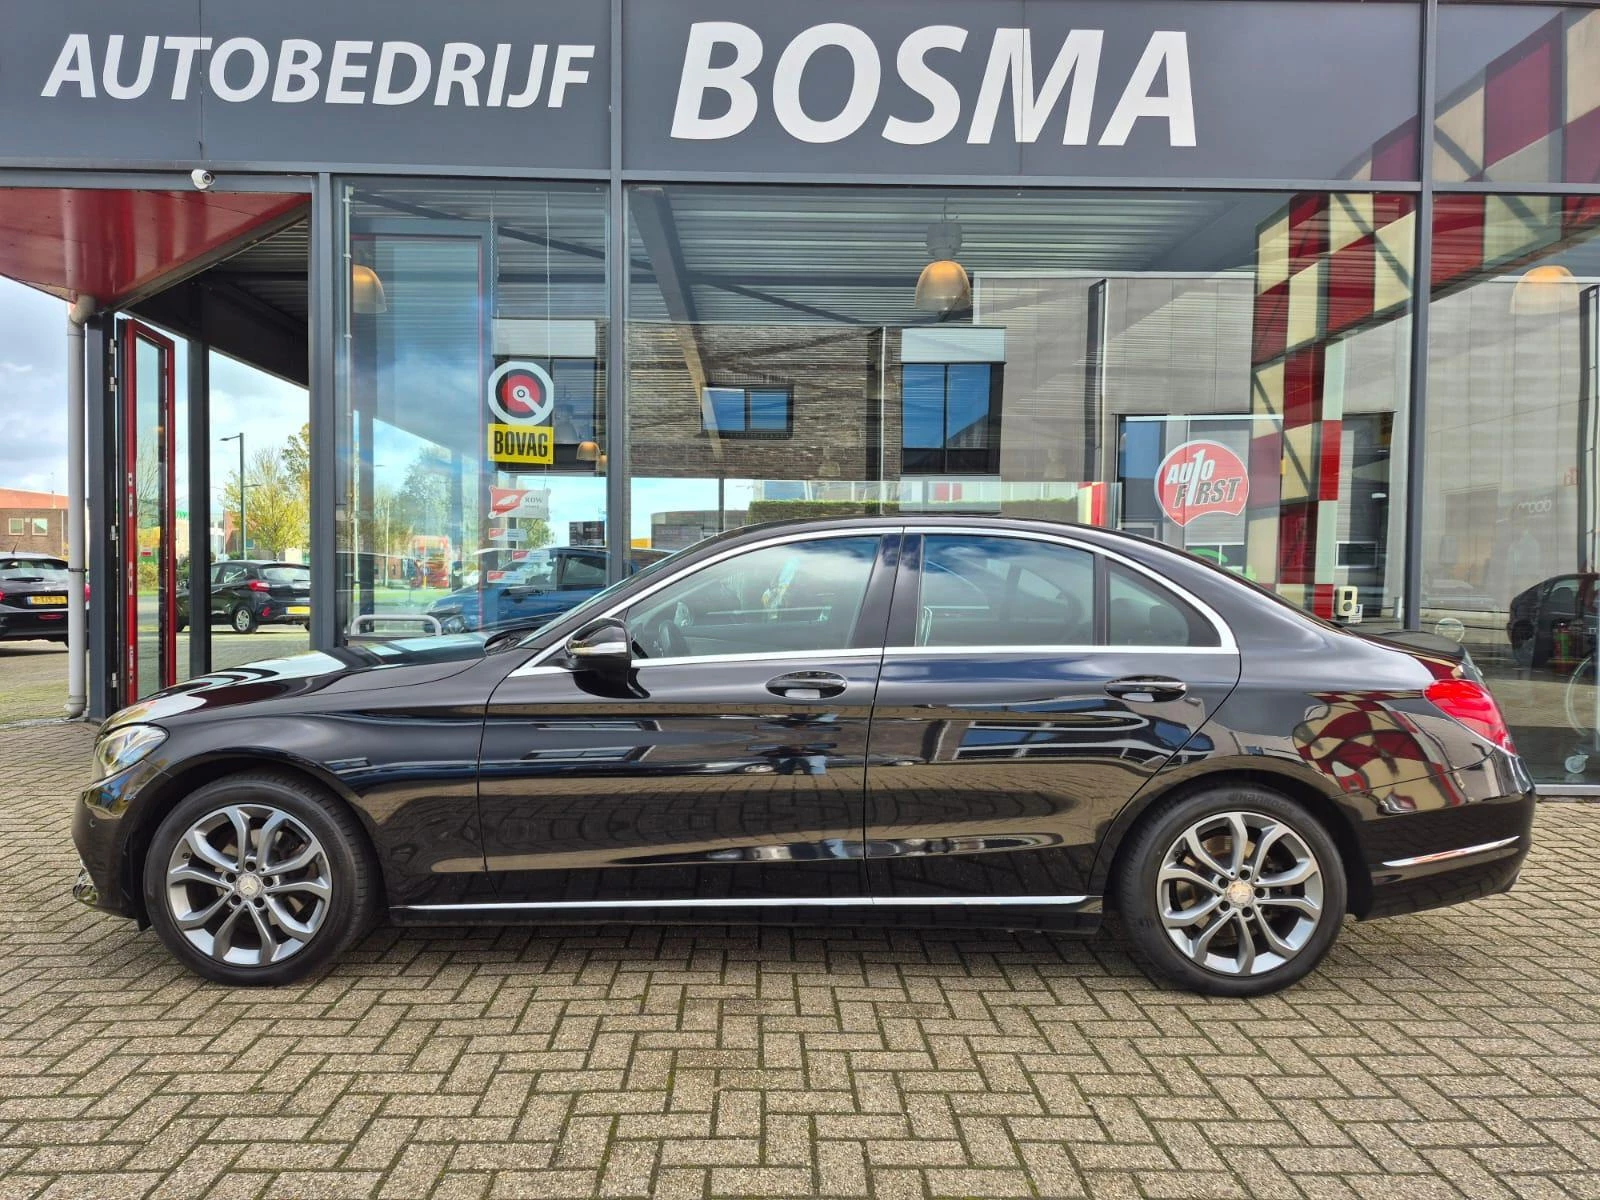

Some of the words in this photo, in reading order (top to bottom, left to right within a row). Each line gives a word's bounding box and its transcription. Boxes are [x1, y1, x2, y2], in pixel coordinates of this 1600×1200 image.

[40, 33, 596, 109] AUTOBEDRIJF
[670, 21, 1197, 147] BOSMA
[494, 430, 548, 458] BOVAG
